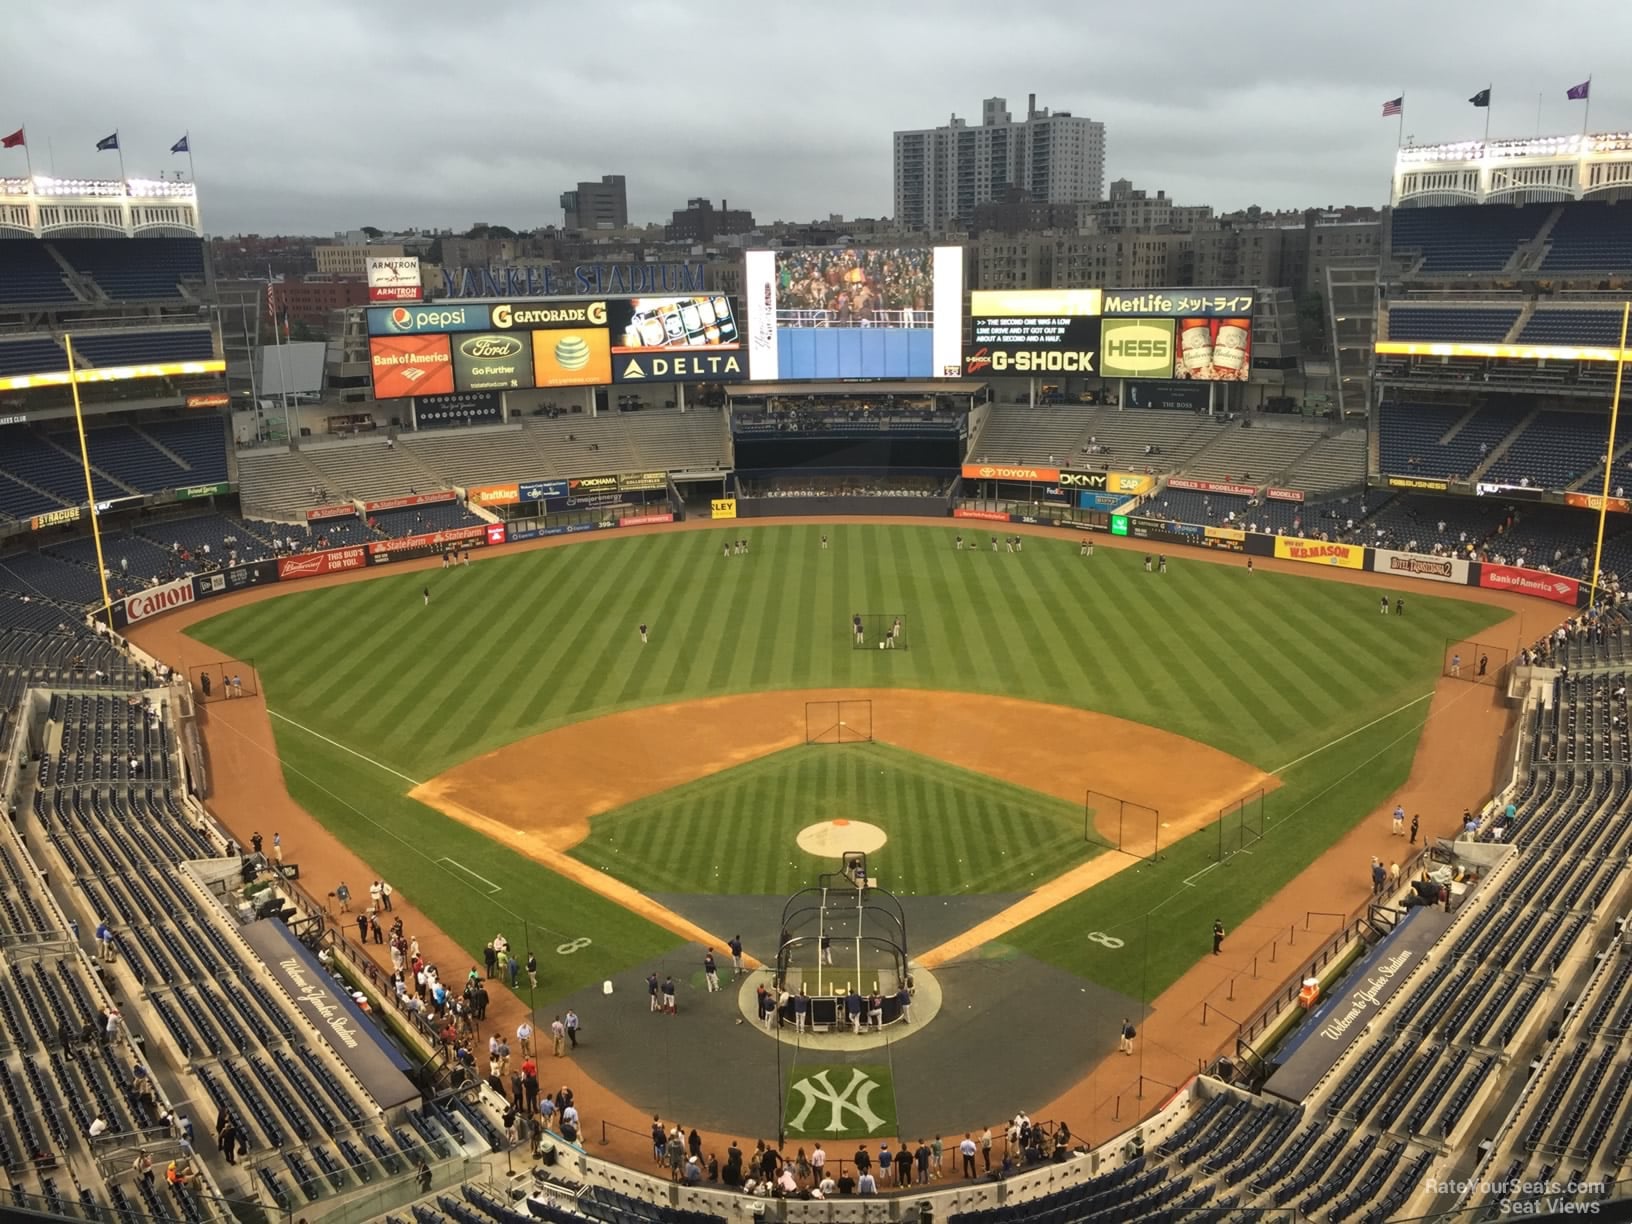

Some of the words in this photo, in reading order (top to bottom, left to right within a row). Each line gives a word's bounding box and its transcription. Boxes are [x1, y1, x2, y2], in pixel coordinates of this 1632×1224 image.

[372, 261, 417, 269] ARMITRON
[441, 266, 560, 298] YANKEE
[575, 263, 705, 294] STADIUM
[377, 287, 417, 296] ARMITRON
[1104, 294, 1172, 312] MetLife
[1177, 297, 1252, 312] メットライフ
[416, 308, 465, 328] pepsi
[514, 311, 586, 323] GATORADE
[472, 340, 510, 356] Ford
[1108, 340, 1168, 357] HESS
[374, 354, 398, 366] Bank
[399, 353, 410, 364] of
[410, 350, 449, 363] America
[652, 356, 741, 376] DELTA
[992, 351, 1095, 371] G-SHOCK
[471, 367, 484, 375] Go
[485, 364, 515, 374] Further
[996, 469, 1038, 478] TOYOTA
[1060, 474, 1105, 487] DKNY
[580, 478, 617, 486] YOKOHAMA
[1120, 479, 1138, 489] SAP
[481, 490, 517, 501] DraftKings
[1047, 487, 1065, 495] FedEx
[1270, 490, 1300, 499] MODELL'S
[38, 508, 80, 524] SYRACUSE
[327, 553, 343, 561] THIS
[344, 548, 364, 558] BUD'S
[285, 561, 321, 572] Budweiser
[328, 560, 342, 569] FOR
[342, 558, 358, 567] YOU.
[1391, 557, 1409, 570] HOTEL
[1444, 561, 1451, 577] 2
[1489, 572, 1511, 584] Bank
[1511, 576, 1520, 585] of
[1520, 578, 1552, 592] America
[127, 583, 193, 619] Canon
[1377, 950, 1412, 978] Stadium
[280, 957, 306, 988] Welcome
[301, 984, 313, 995] to
[1353, 974, 1389, 1006] Yankee
[297, 989, 337, 1019] Yankee
[1352, 999, 1367, 1013] to
[326, 1013, 359, 1049] Stadium
[1320, 1007, 1361, 1041] Welcome
[788, 1067, 887, 1133] NY
